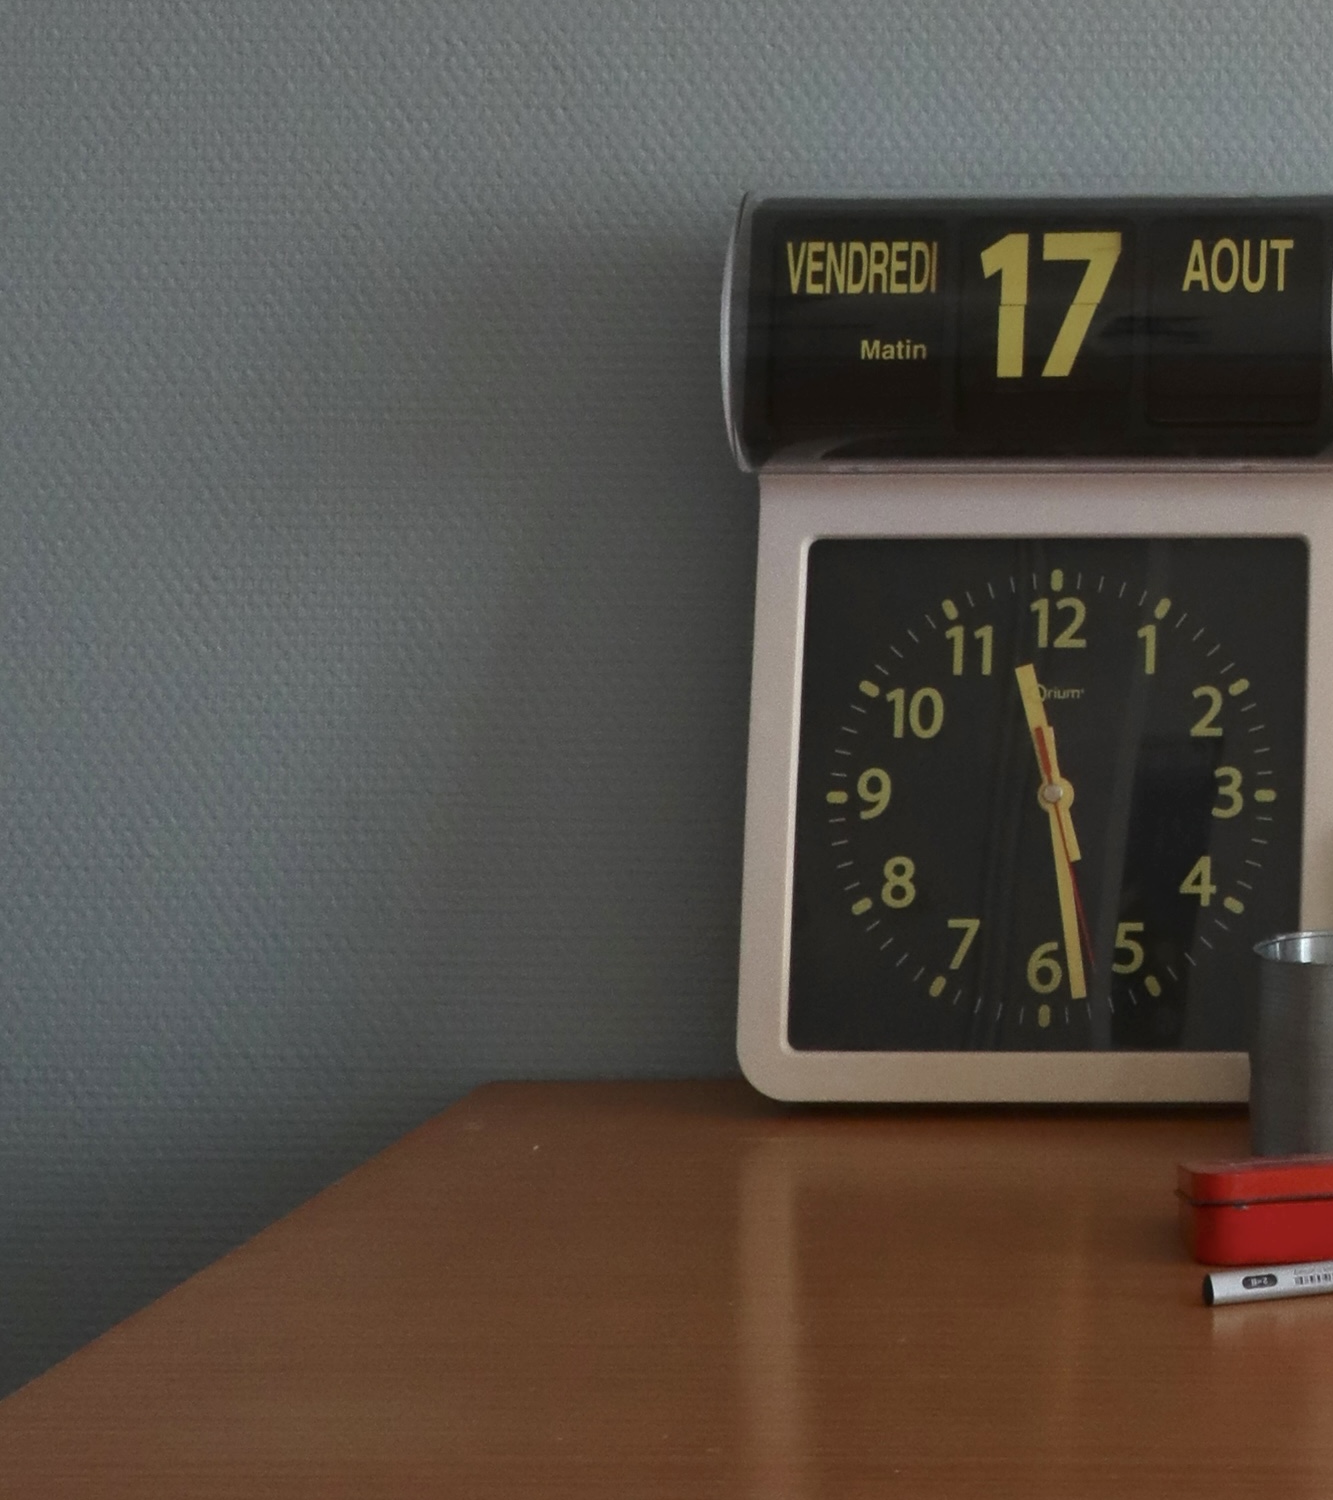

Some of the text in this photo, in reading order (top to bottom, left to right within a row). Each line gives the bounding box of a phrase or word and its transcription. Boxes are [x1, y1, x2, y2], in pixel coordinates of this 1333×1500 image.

[786, 240, 938, 294] VENDREDI
[1181, 237, 1295, 293] AOUT
[980, 230, 1122, 378] 17
[859, 338, 927, 361] Matin
[1030, 597, 1088, 650] 12
[1136, 624, 1157, 674] 1
[945, 624, 994, 677] 11
[885, 687, 945, 739] 10
[1189, 685, 1224, 737] 2
[856, 768, 892, 820] 9
[1210, 766, 1245, 819] 3
[880, 855, 917, 908] 8
[1178, 856, 1218, 907] 4
[946, 919, 981, 970] 7
[1027, 941, 1064, 994] 6
[1112, 922, 1147, 974] 5
